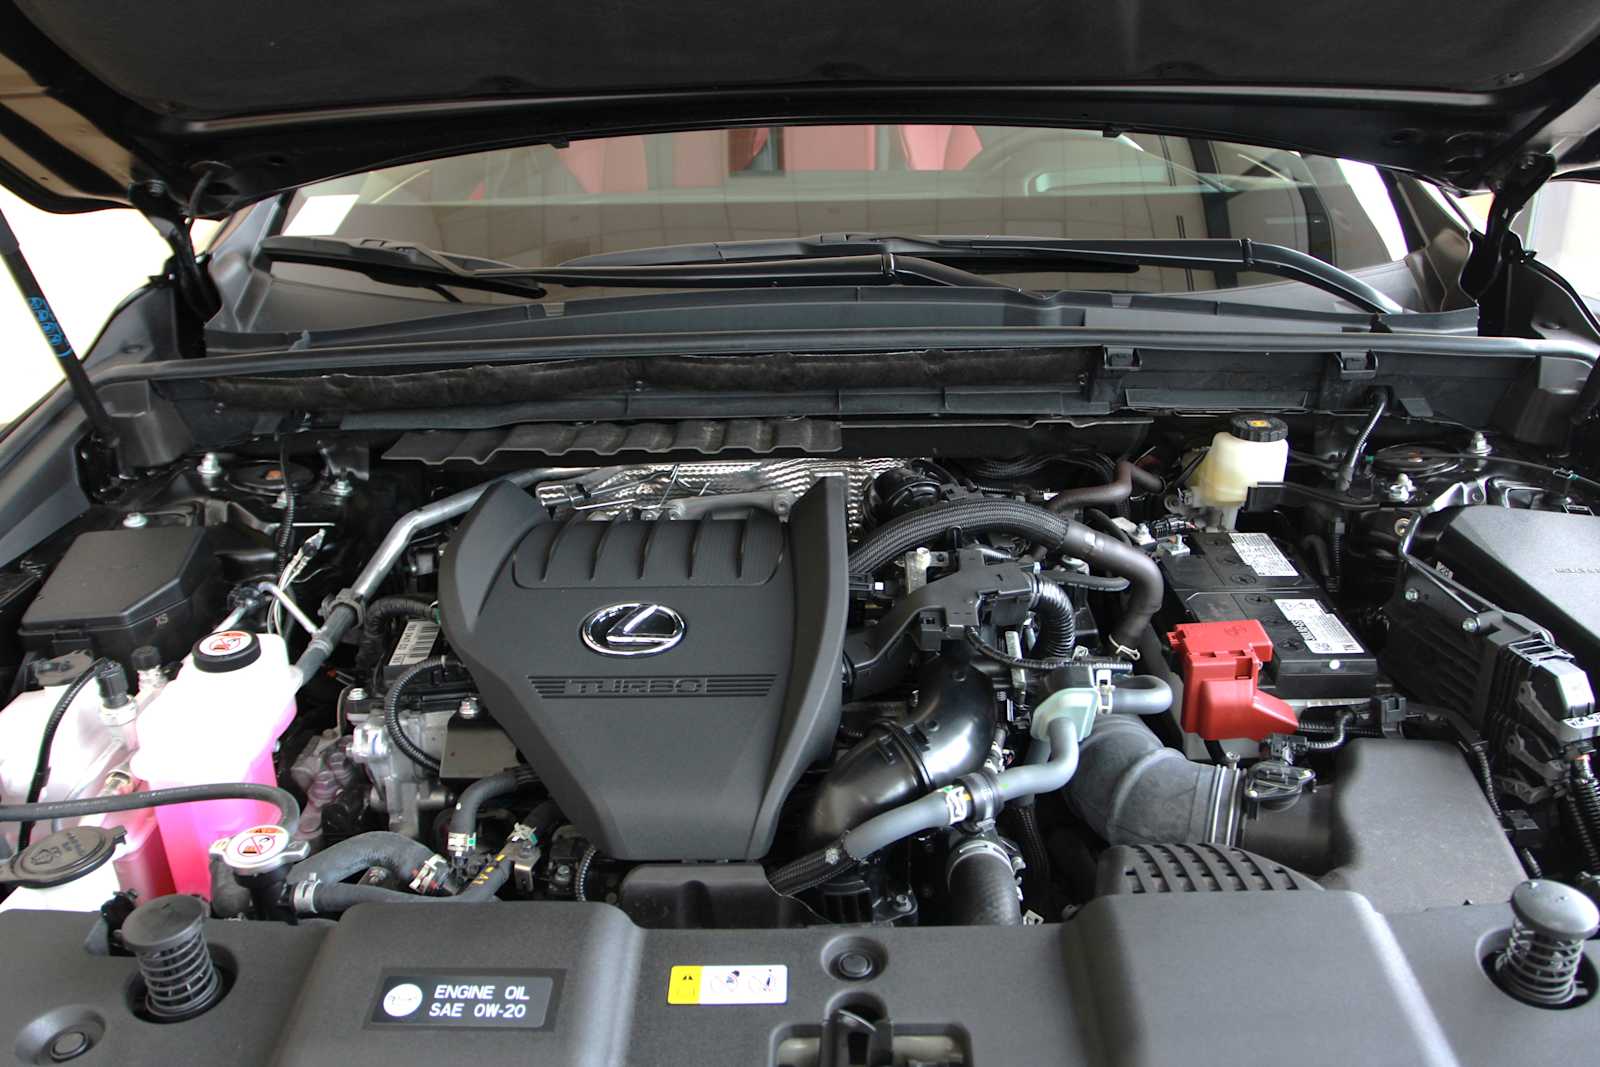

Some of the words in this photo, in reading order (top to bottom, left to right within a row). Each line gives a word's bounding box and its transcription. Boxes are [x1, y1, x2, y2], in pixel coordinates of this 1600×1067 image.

[568, 678, 707, 696] TURBO
[434, 984, 495, 999] ENGINE
[504, 985, 531, 1000] OIL
[429, 1003, 465, 1017] SAE
[474, 1003, 527, 1018] 0W-20
